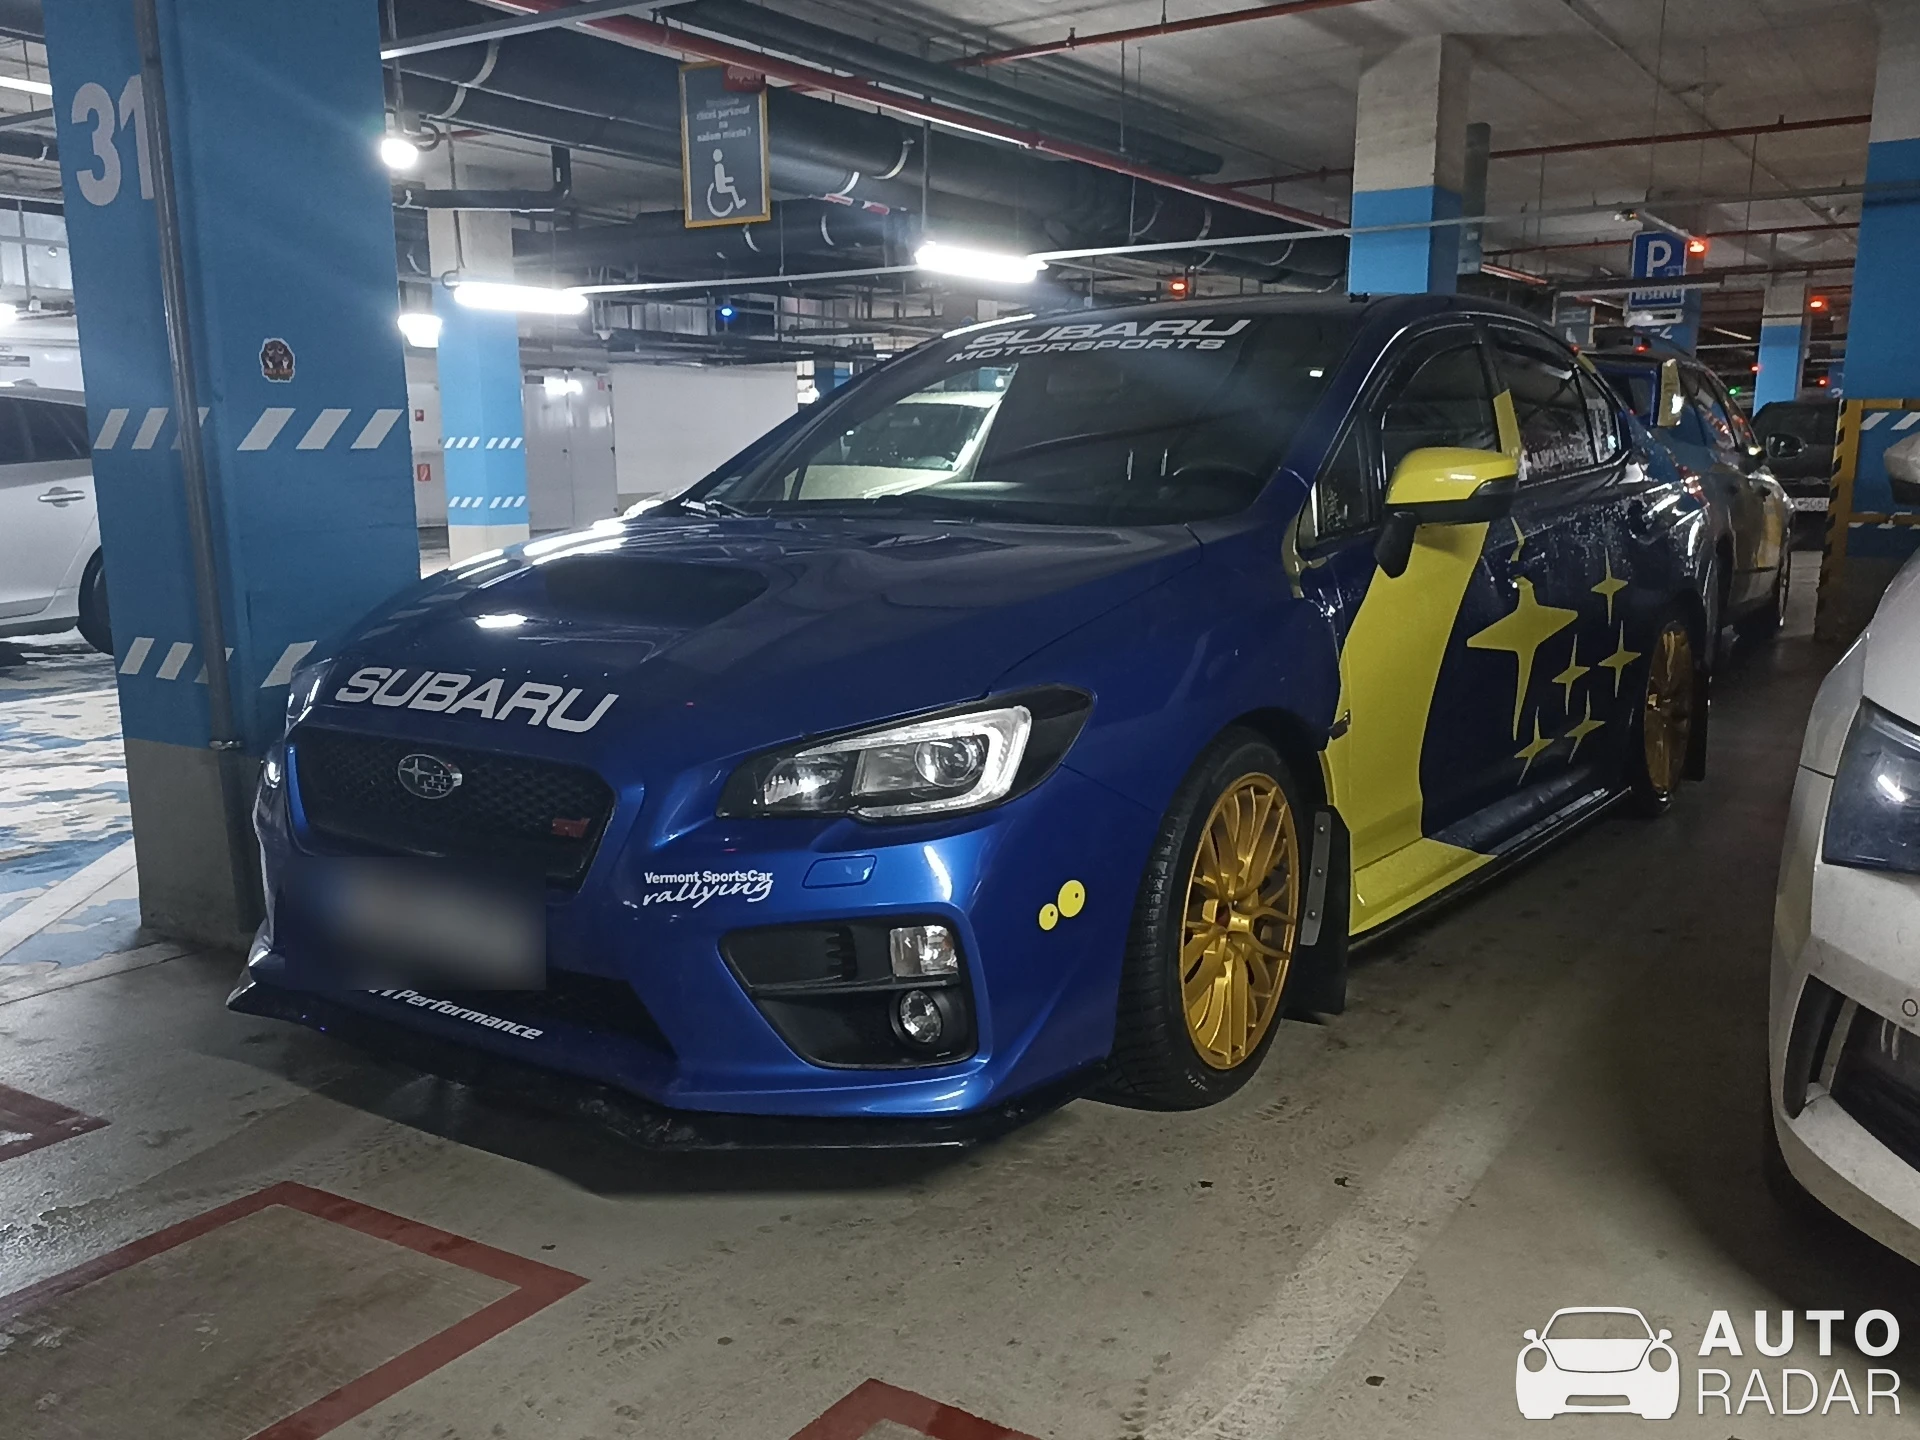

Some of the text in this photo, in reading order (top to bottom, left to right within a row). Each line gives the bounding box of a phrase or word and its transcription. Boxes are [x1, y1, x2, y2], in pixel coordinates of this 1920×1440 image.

[71, 74, 154, 206] 31
[1646, 240, 1672, 277] P
[945, 338, 1226, 363] MOTORSPORTS
[965, 319, 1251, 350] SUBARU
[335, 667, 619, 733] SUBARU
[642, 880, 774, 908] rallying
[644, 869, 773, 885] Vermont SportsCar
[392, 990, 544, 1040] Performance
